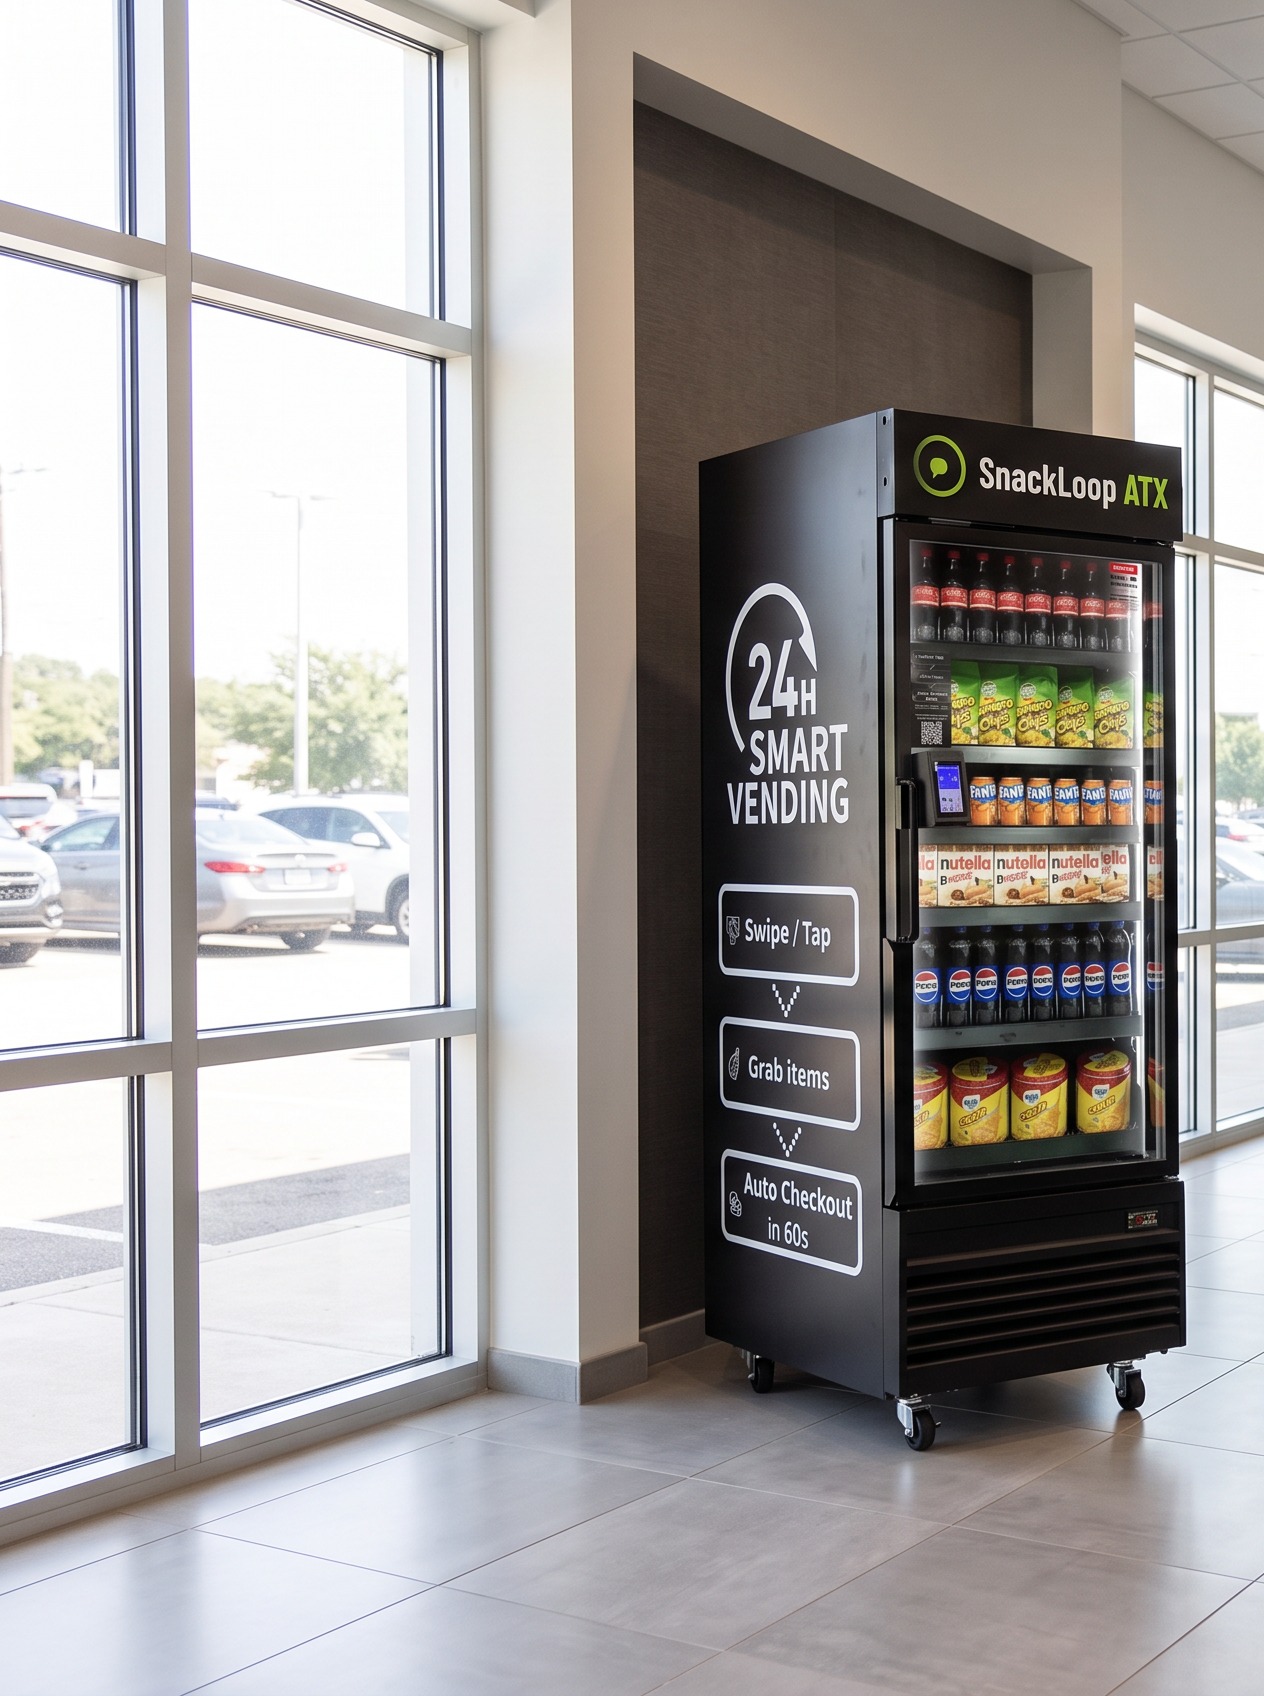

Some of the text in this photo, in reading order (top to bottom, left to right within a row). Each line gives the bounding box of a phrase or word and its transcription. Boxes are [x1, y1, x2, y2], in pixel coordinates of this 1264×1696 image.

[979, 457, 1169, 510] SnackLoop ATX
[748, 639, 817, 720] 24H
[750, 724, 848, 776] SMART
[727, 777, 849, 824] VENDING
[941, 855, 991, 870] nutella
[997, 855, 1046, 870] nutella
[1052, 854, 1099, 869] nutella
[744, 917, 831, 953] Swipe / Tap
[748, 1055, 830, 1091] Grab items
[744, 1172, 854, 1220] Auto Checkout
[768, 1217, 809, 1250] in 60s
